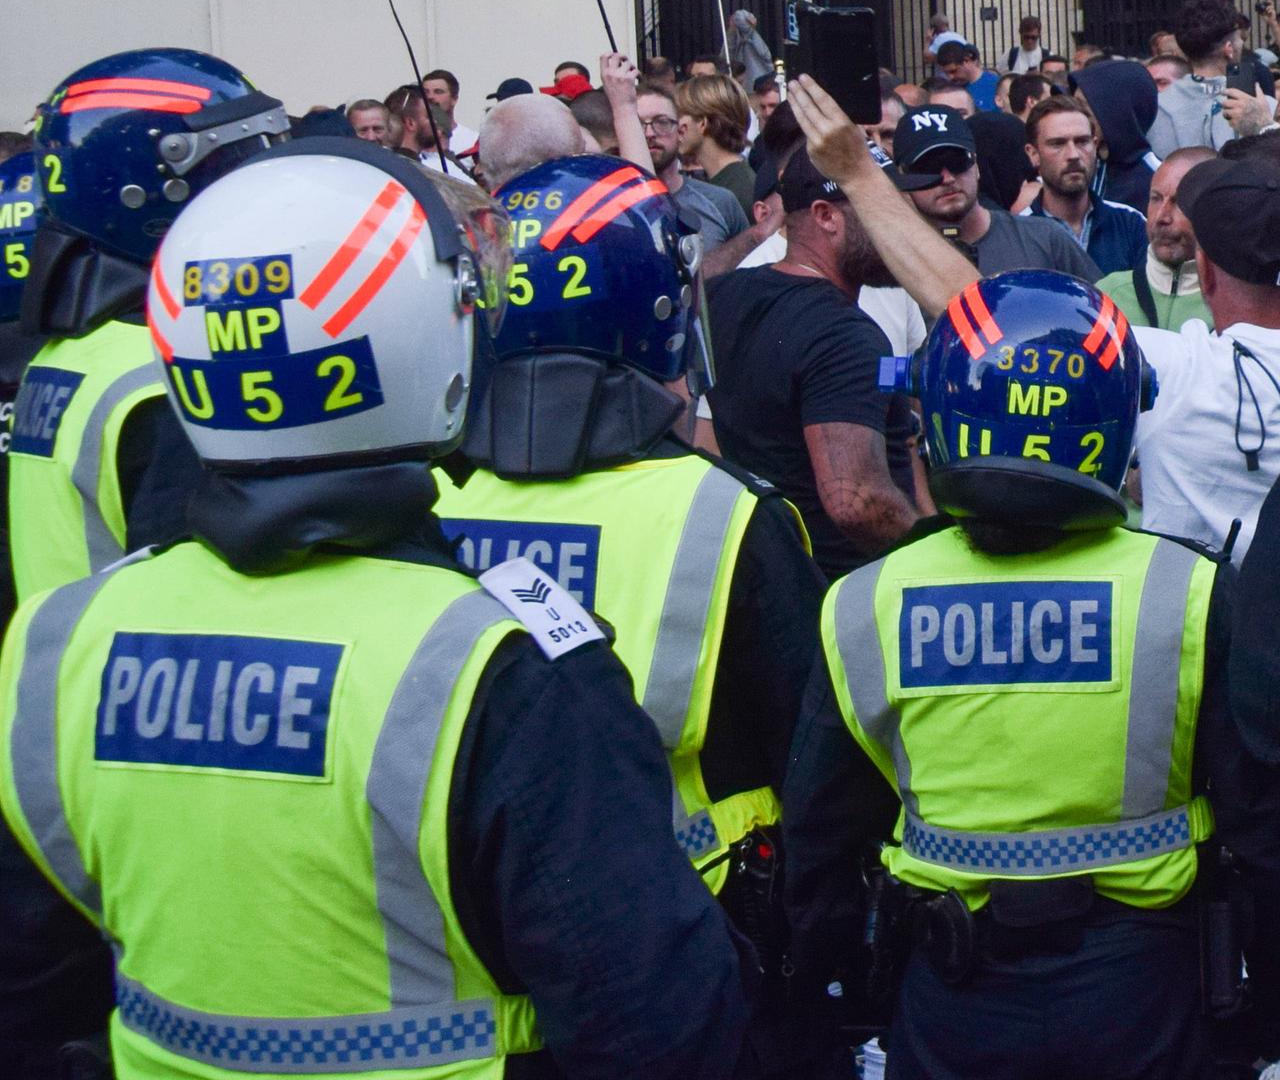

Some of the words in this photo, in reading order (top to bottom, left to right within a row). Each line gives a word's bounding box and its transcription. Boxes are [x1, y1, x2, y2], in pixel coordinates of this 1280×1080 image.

[911, 110, 948, 132] NY
[44, 154, 67, 193] 2
[499, 191, 564, 211] 966
[5, 243, 30, 279] 5
[183, 260, 291, 300] 8309
[205, 307, 281, 352] MP
[997, 346, 1085, 379] 3370
[1008, 383, 1068, 417] MP
[910, 599, 1100, 668] POLICE
[102, 656, 321, 749] POLICE
